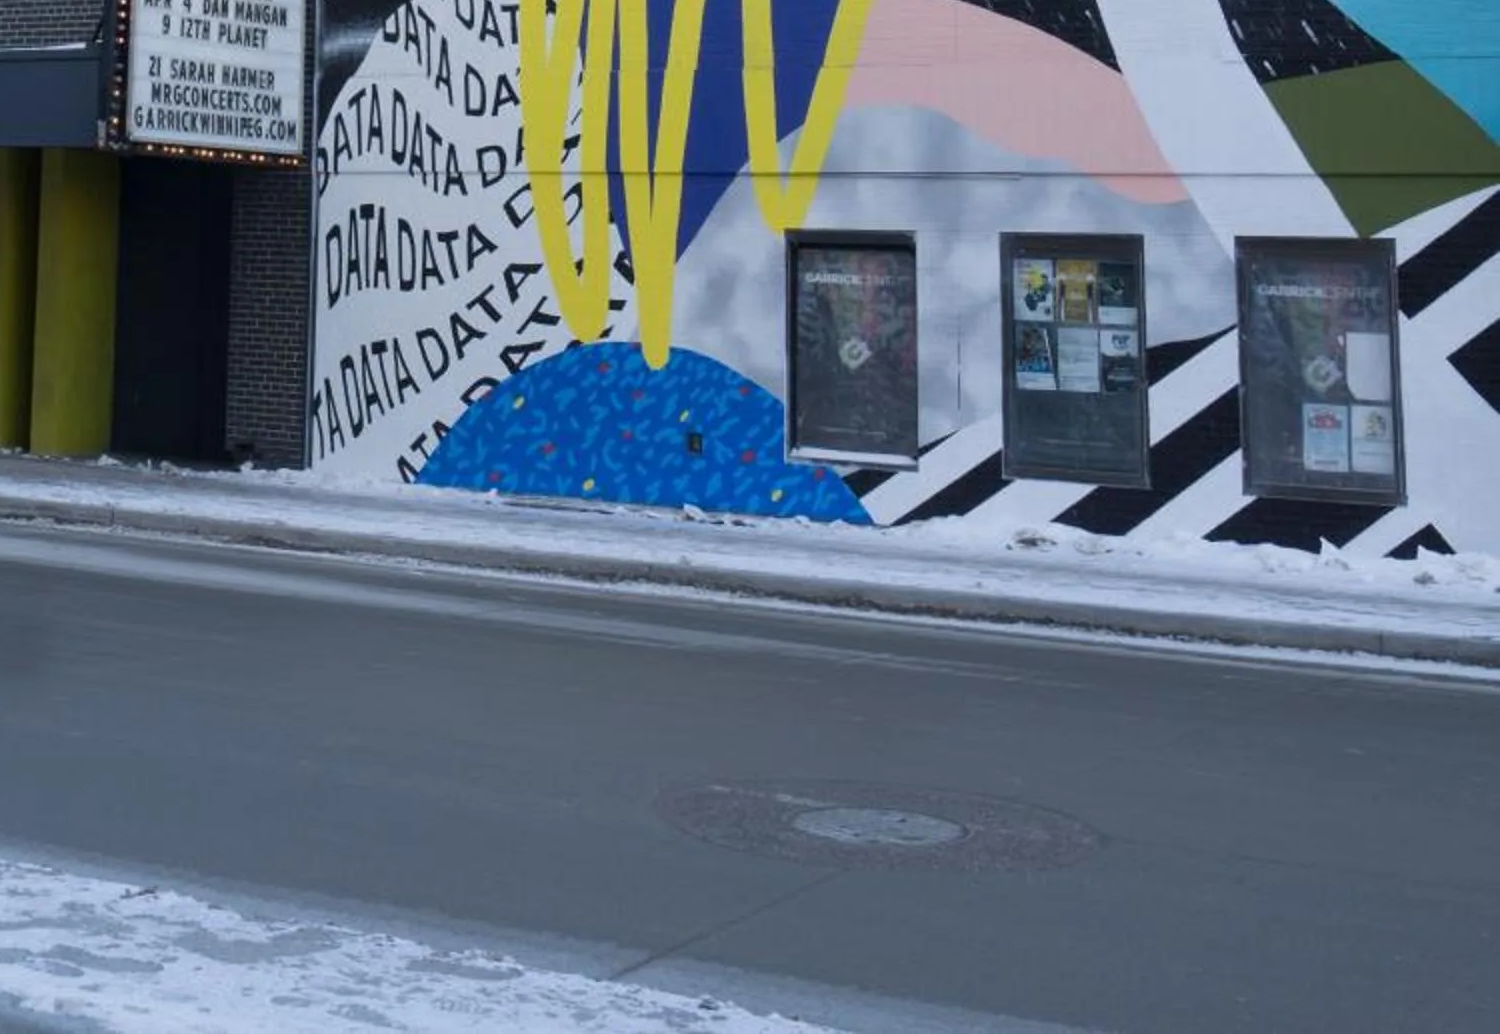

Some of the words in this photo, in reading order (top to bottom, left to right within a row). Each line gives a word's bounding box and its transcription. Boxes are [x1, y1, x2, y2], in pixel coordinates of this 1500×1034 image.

[162, 14, 171, 35] 9
[180, 18, 211, 41] 12TH
[218, 22, 268, 50] PLANET
[235, 1, 288, 27] MANGAN
[148, 56, 161, 78] 21
[170, 58, 215, 84] SARAH
[392, 88, 468, 197] DATA
[326, 203, 390, 310] DATA
[398, 217, 498, 293] DATA
[340, 337, 421, 439] DATA
[416, 263, 543, 382] DATA
